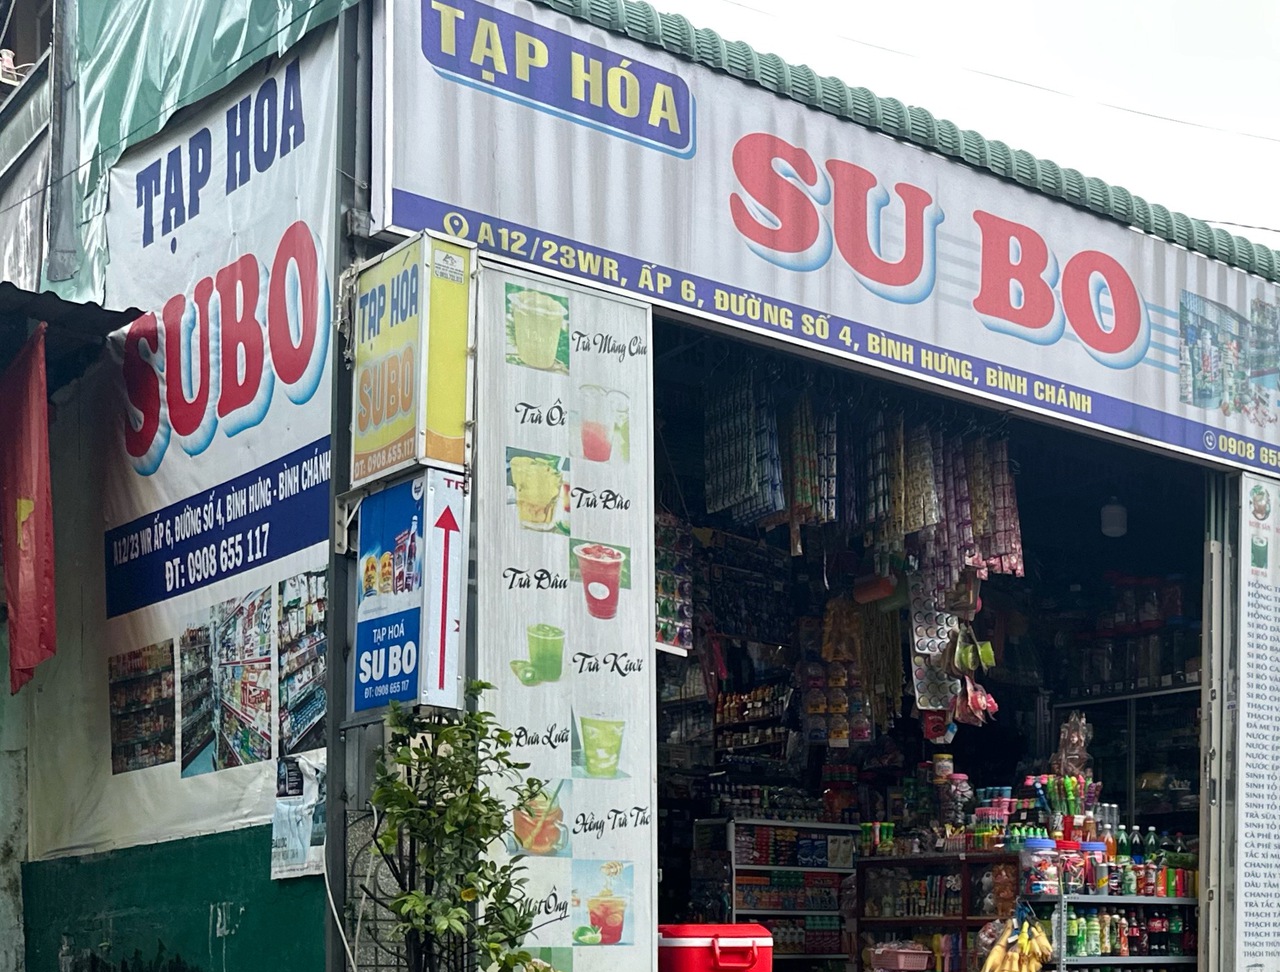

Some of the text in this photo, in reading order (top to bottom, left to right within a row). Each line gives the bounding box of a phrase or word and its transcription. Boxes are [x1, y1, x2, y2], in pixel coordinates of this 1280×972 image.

[431, 0, 681, 135] TẠP HÓA
[136, 127, 212, 254] TẠP
[730, 132, 1146, 362] SU BO
[359, 251, 419, 350] TẠP HÓA
[477, 222, 628, 288] A12/23WR,
[638, 262, 672, 295] ẤP
[680, 280, 704, 308] 6,
[713, 288, 793, 330] ĐƯỜNG
[801, 313, 831, 340] SỐ
[838, 325, 860, 351] 4,
[867, 332, 914, 366] BÌNH
[920, 348, 979, 386] HƯNG,
[986, 366, 1028, 396] BÌNH
[1034, 382, 1093, 414] CHÁNH
[122, 220, 328, 470] SUBO
[571, 330, 591, 352] Trà
[358, 346, 415, 433] SUBO
[514, 402, 543, 425] Trà
[367, 437, 415, 474] 0908.655.117
[1218, 434, 1255, 460] 0908
[174, 504, 202, 542] ĐƯỜNG
[203, 490, 216, 532] SỐ
[216, 499, 225, 530] 4,
[226, 485, 247, 523] BÌNH
[248, 477, 272, 513] HƯNG
[278, 463, 300, 501] BÌNH
[301, 448, 332, 491] CHÁNH
[570, 487, 599, 509] Trà
[165, 522, 270, 592] ĐT: 0908 655 117
[503, 567, 531, 590] Trà
[373, 626, 387, 646] TẠP
[359, 640, 417, 684] SU BO
[572, 652, 643, 677] Trà Kiwi
[374, 684, 389, 697] 0908
[389, 681, 401, 694] 655
[401, 679, 410, 692] 117
